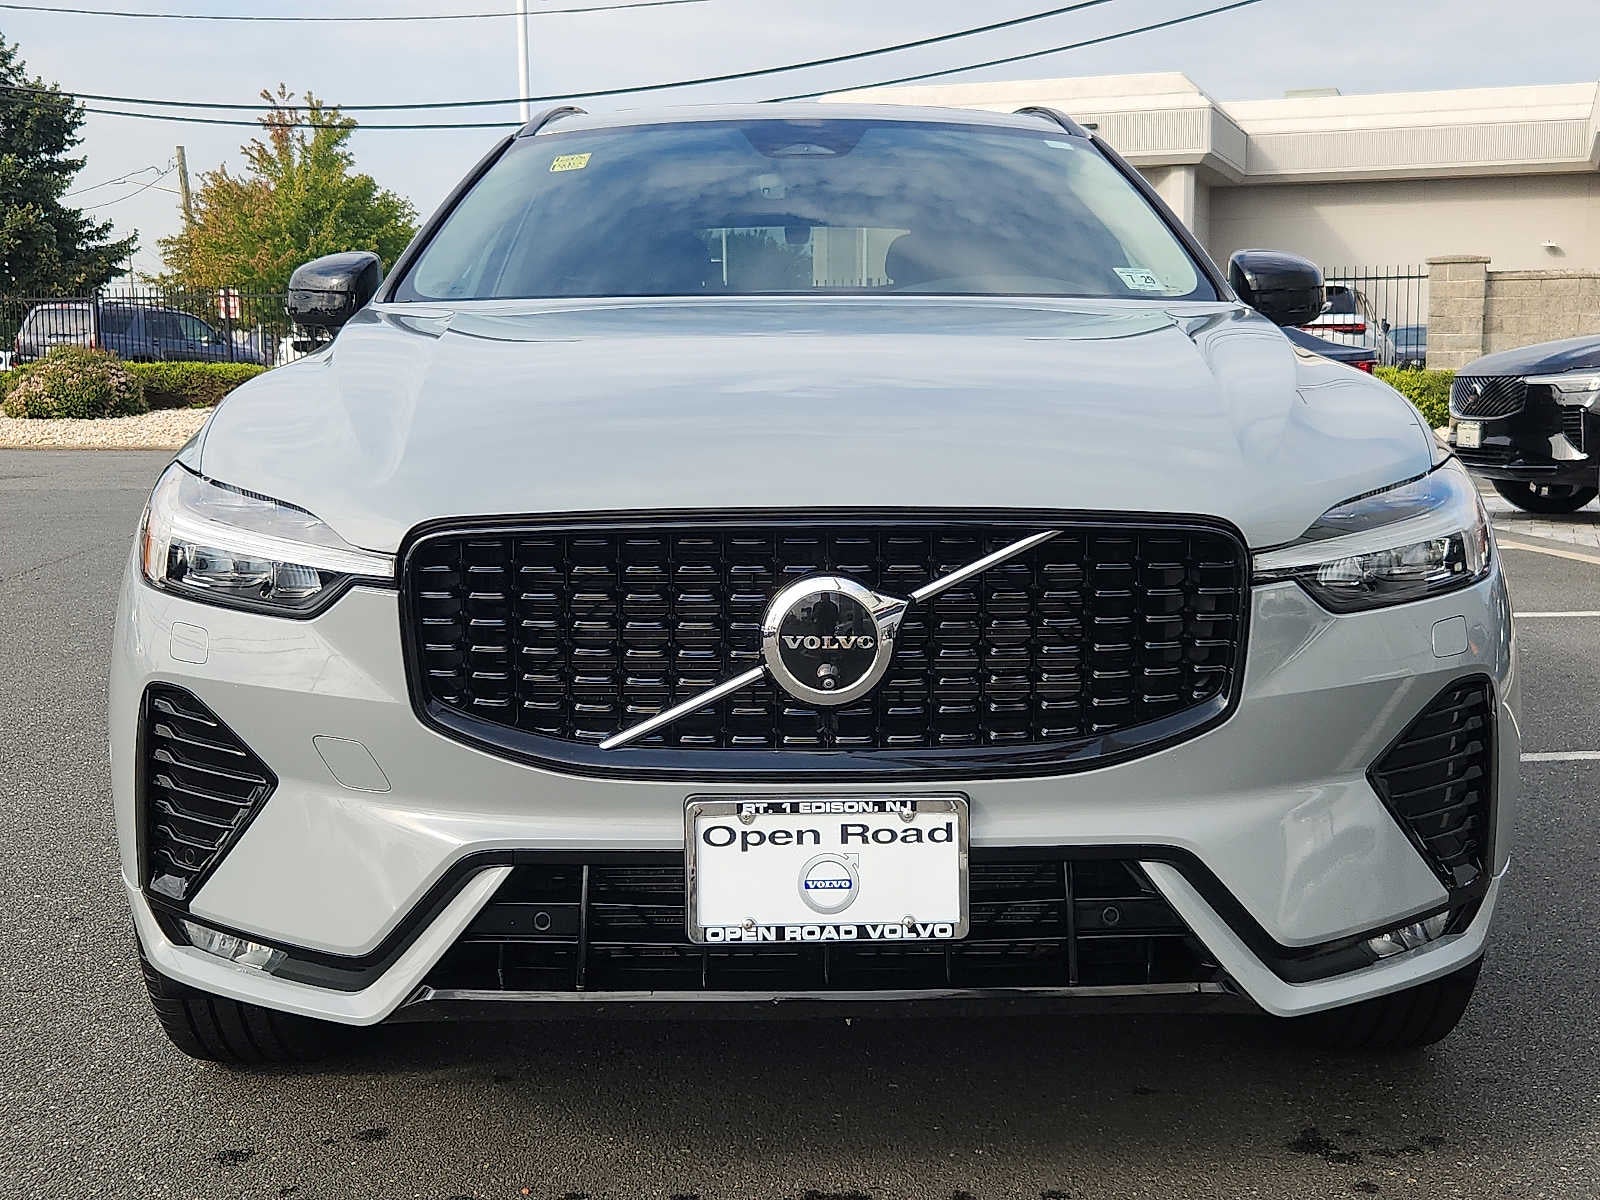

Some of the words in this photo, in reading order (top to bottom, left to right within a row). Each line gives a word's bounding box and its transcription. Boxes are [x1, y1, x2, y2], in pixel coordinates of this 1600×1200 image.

[781, 635, 875, 649] VOLVO
[742, 802, 773, 814] RT.
[781, 802, 791, 814] 1
[885, 800, 912, 813] NJ
[702, 825, 821, 852] Open
[840, 821, 953, 845] Road
[807, 879, 850, 888] VOLVO
[705, 926, 777, 942] OPEN
[784, 925, 858, 940] ROAD
[864, 923, 953, 939] VOLVO
